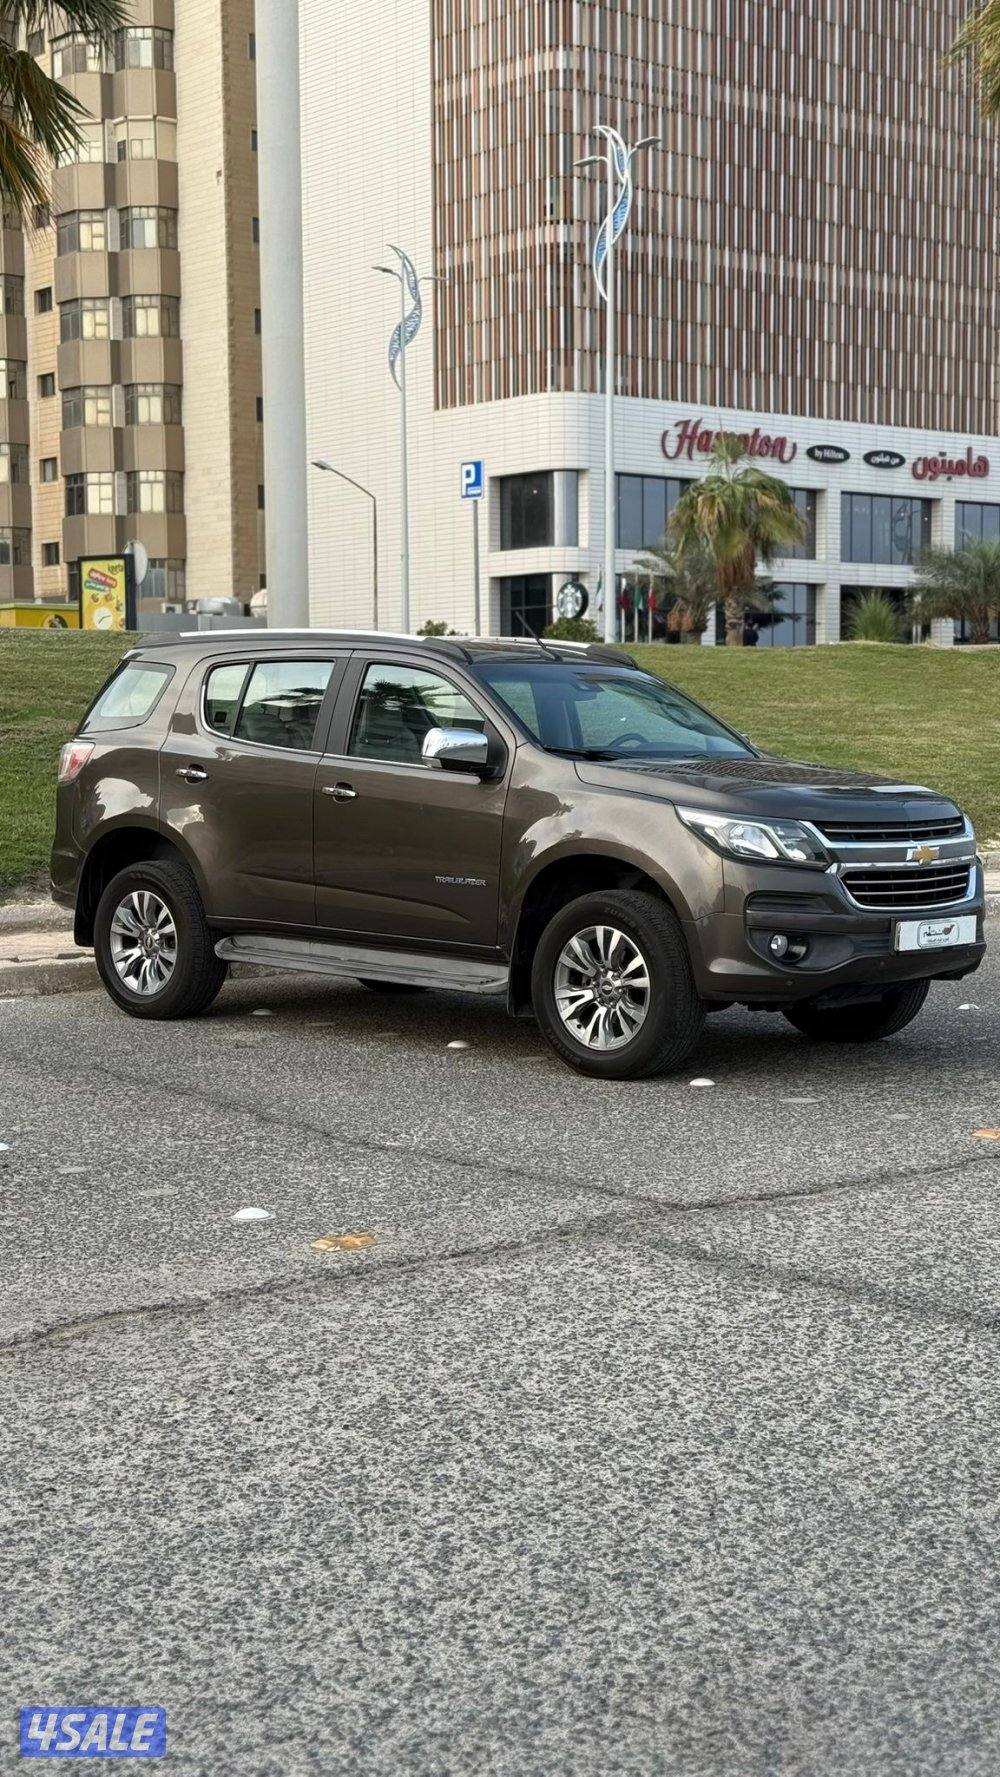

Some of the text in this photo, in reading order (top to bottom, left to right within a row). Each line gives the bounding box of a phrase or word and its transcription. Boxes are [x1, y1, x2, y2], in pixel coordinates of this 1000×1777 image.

[814, 448, 845, 460] by Hilton
[912, 446, 990, 481] هامبتون
[461, 463, 476, 496] P
